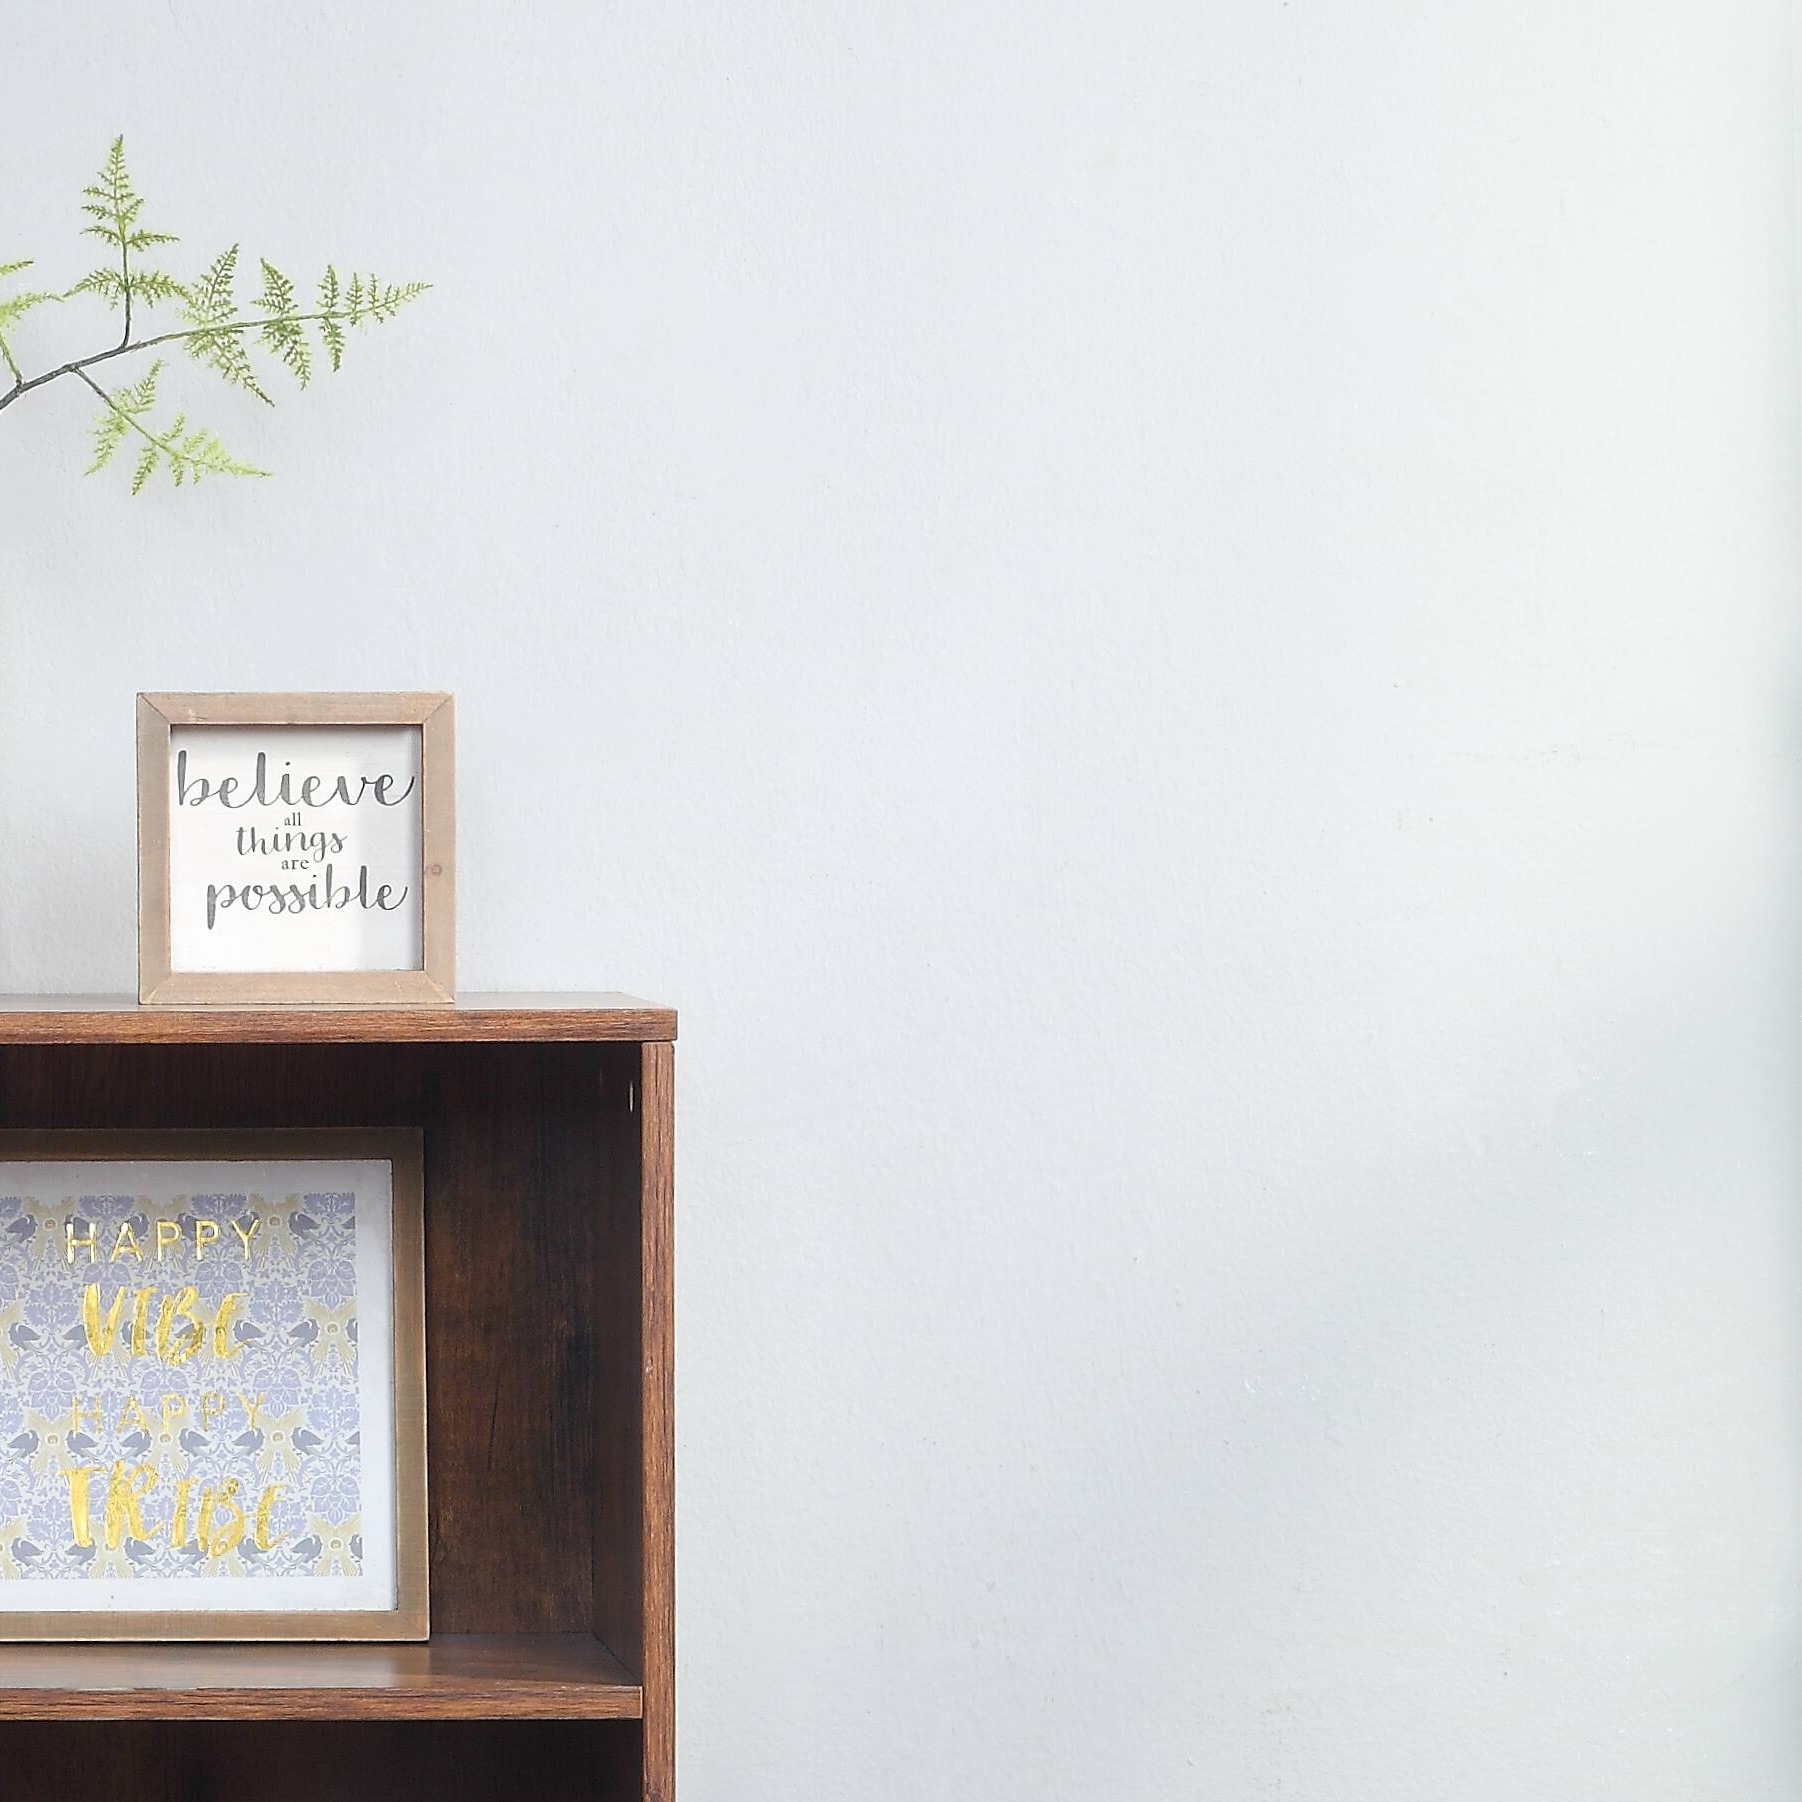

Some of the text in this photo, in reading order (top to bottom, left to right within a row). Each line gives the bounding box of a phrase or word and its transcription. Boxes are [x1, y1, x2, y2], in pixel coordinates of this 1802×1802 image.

[177, 750, 415, 809] believe
[283, 812, 302, 826] all
[235, 826, 348, 862] things
[281, 859, 309, 870] are
[207, 863, 408, 930] possible
[65, 1218, 262, 1264] HAPPY
[81, 1282, 249, 1367] VIBE
[71, 1391, 267, 1434] HAPPY
[59, 1459, 293, 1560] TRIBE
